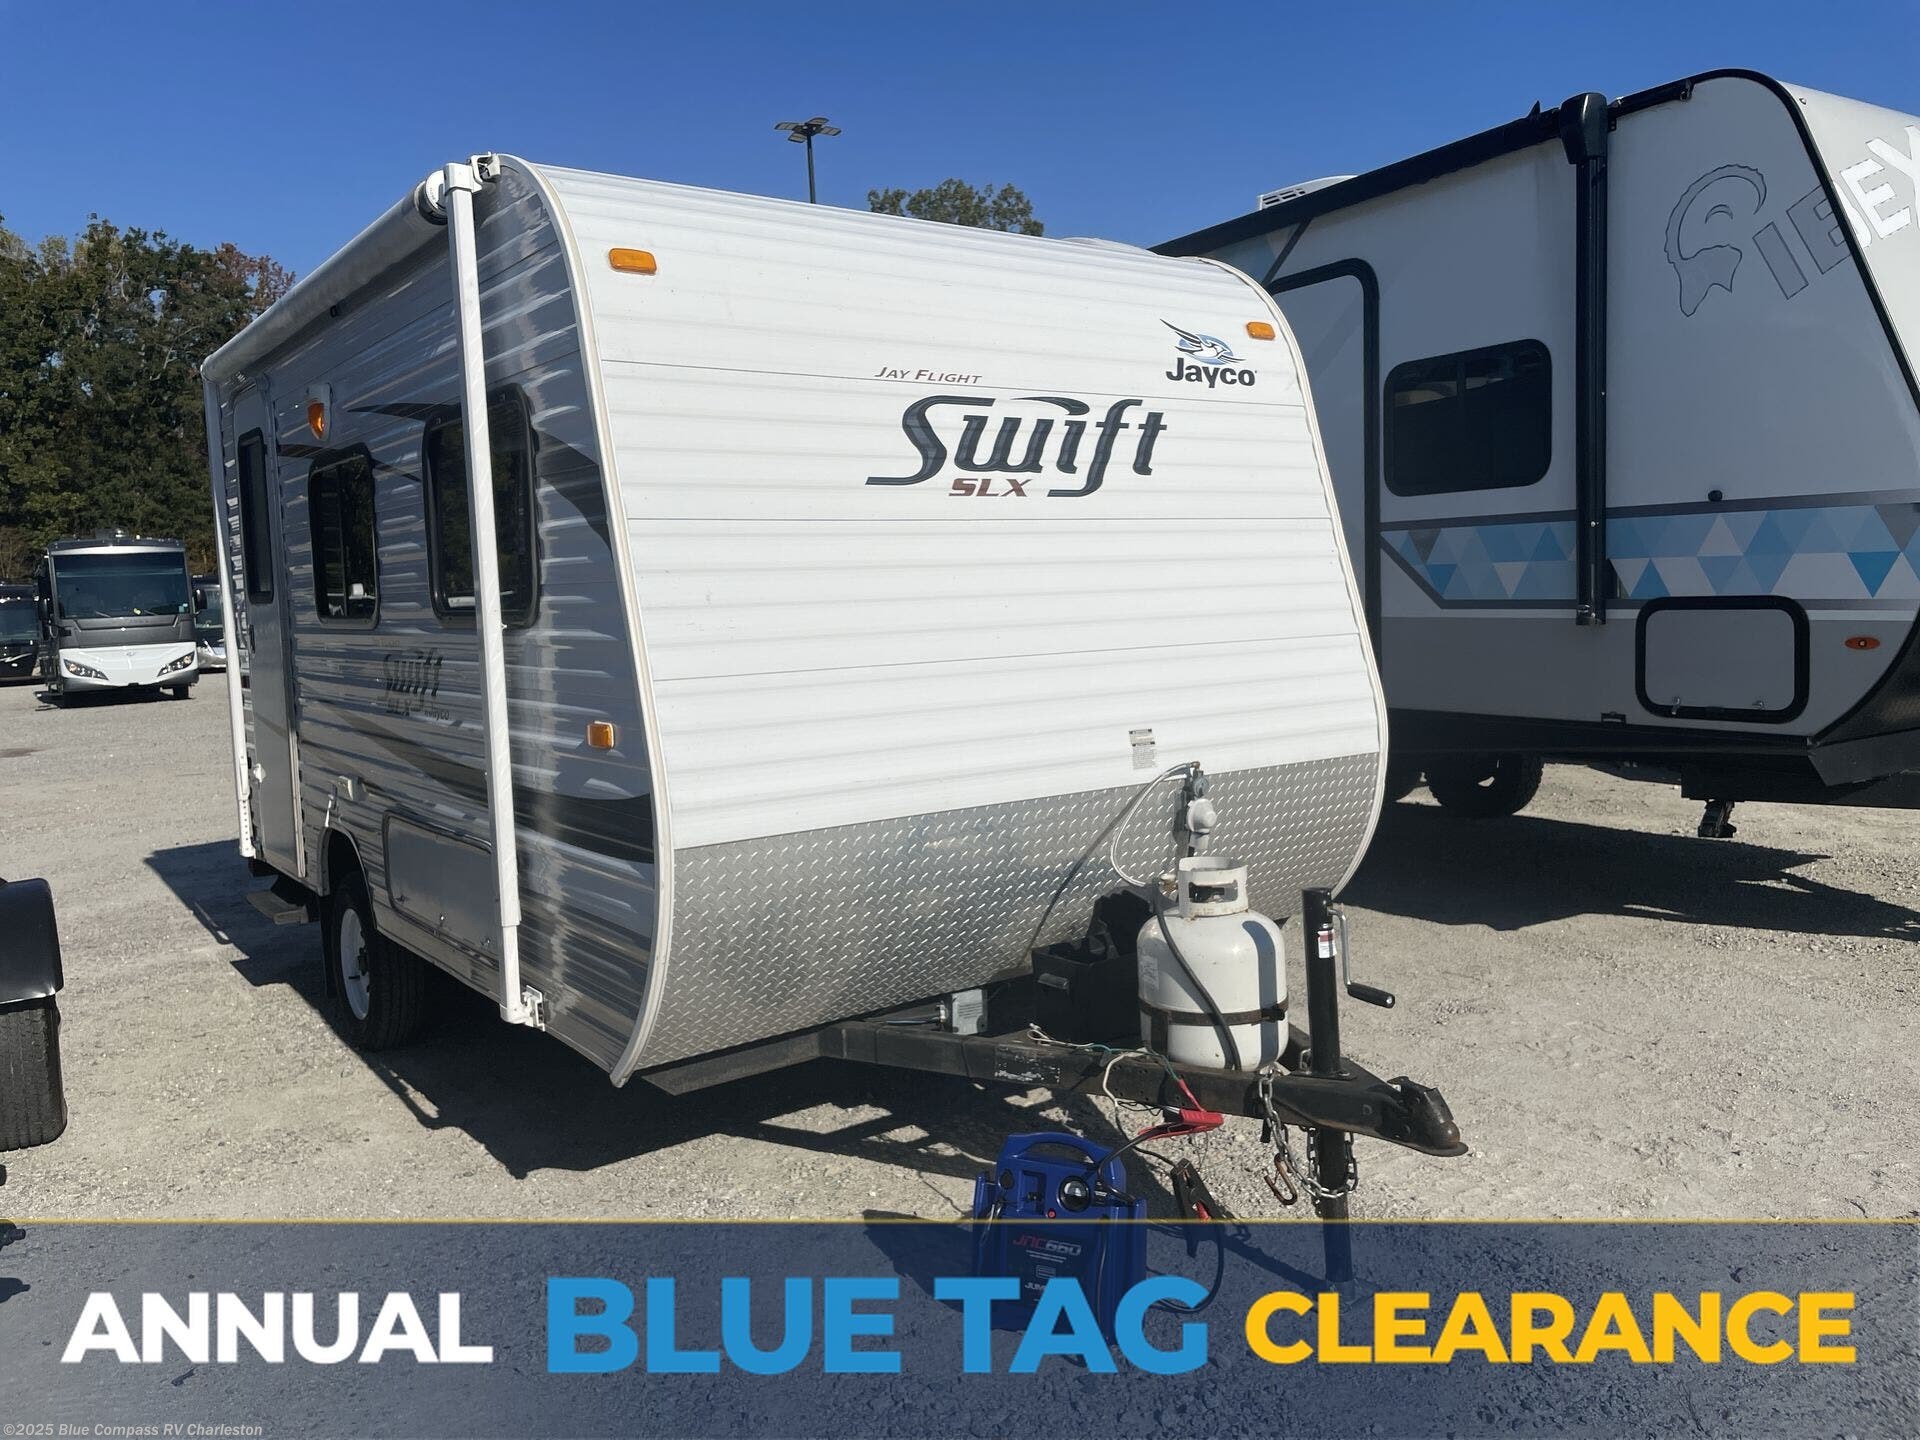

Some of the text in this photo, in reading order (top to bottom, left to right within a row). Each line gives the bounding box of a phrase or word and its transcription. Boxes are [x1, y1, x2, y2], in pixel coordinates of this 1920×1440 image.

[874, 366, 982, 385] JAY FLIGHT
[1166, 357, 1256, 388] Jayco
[865, 394, 1168, 498] Swift
[948, 477, 1032, 498] SLX
